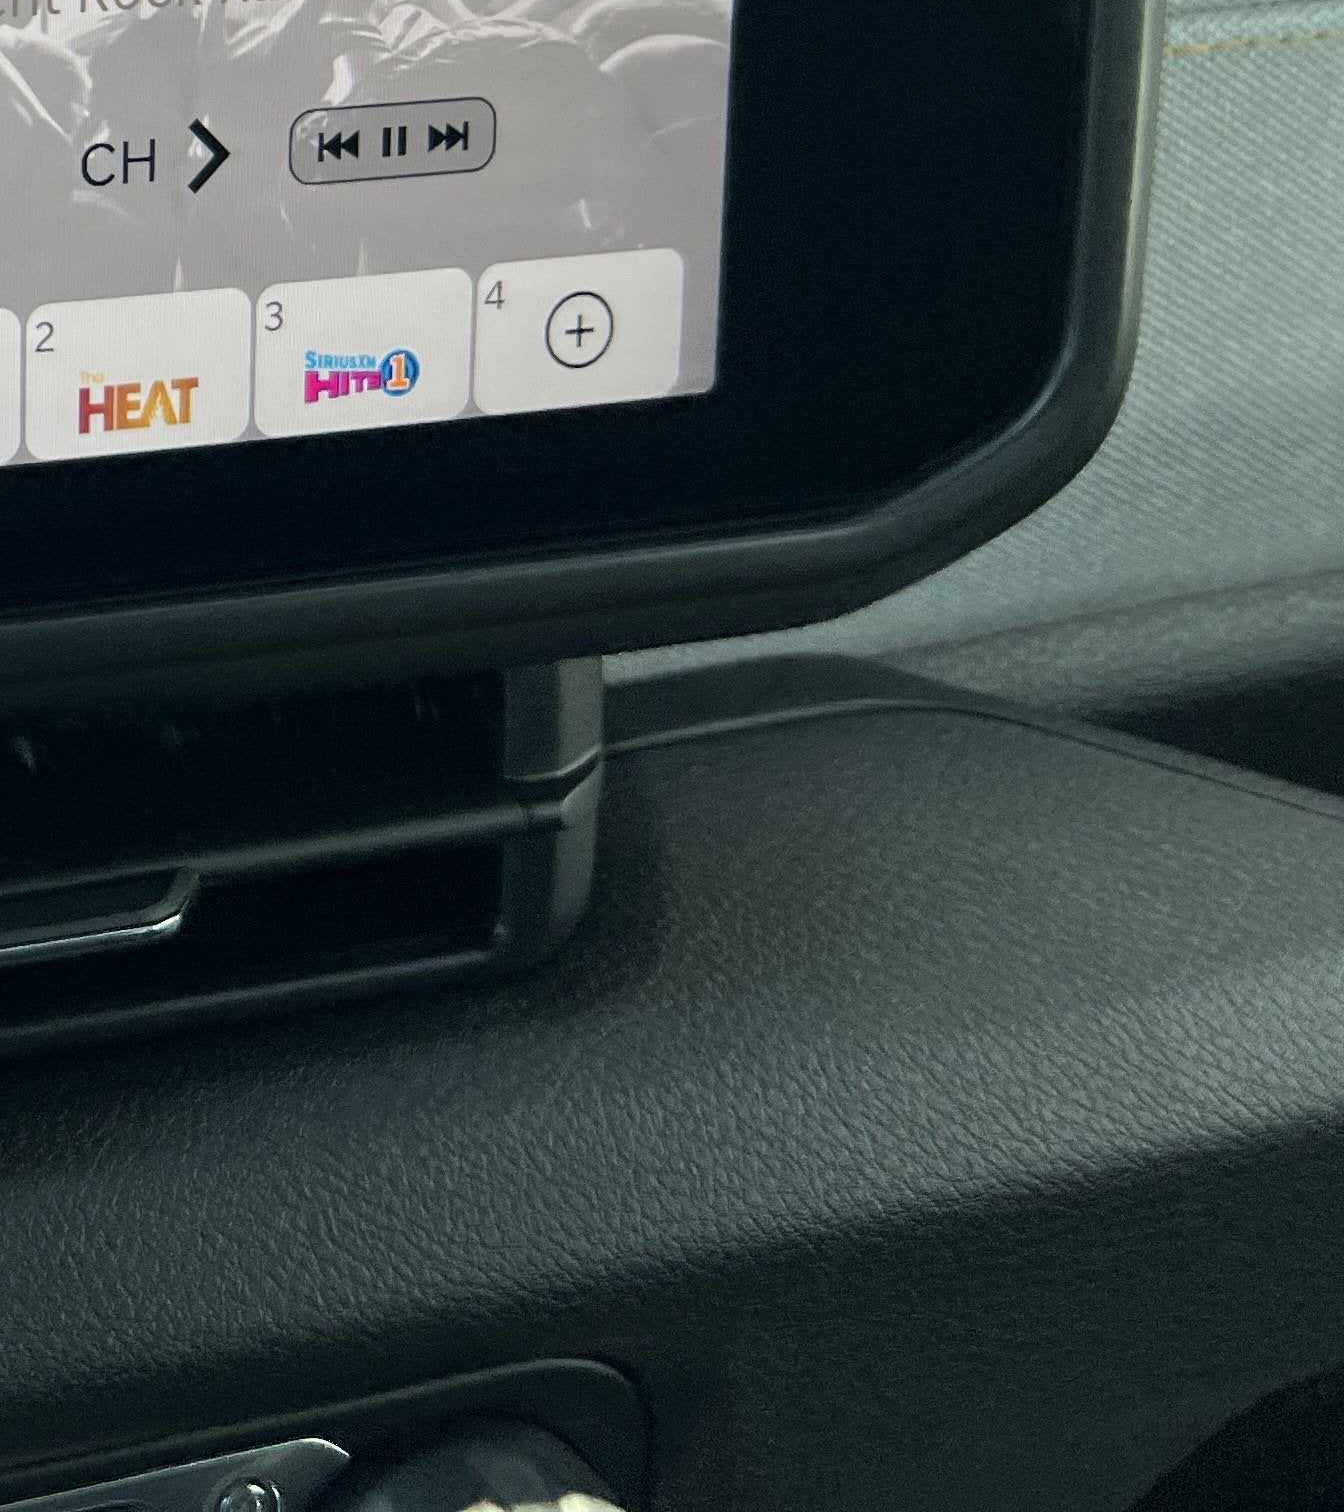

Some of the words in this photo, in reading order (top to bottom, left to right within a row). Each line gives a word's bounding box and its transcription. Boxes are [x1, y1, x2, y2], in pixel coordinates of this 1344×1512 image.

[79, 138, 158, 188] CH
[483, 279, 507, 311] 4
[263, 299, 286, 333] 3
[33, 320, 56, 354] 2
[78, 376, 200, 434] HEAT
